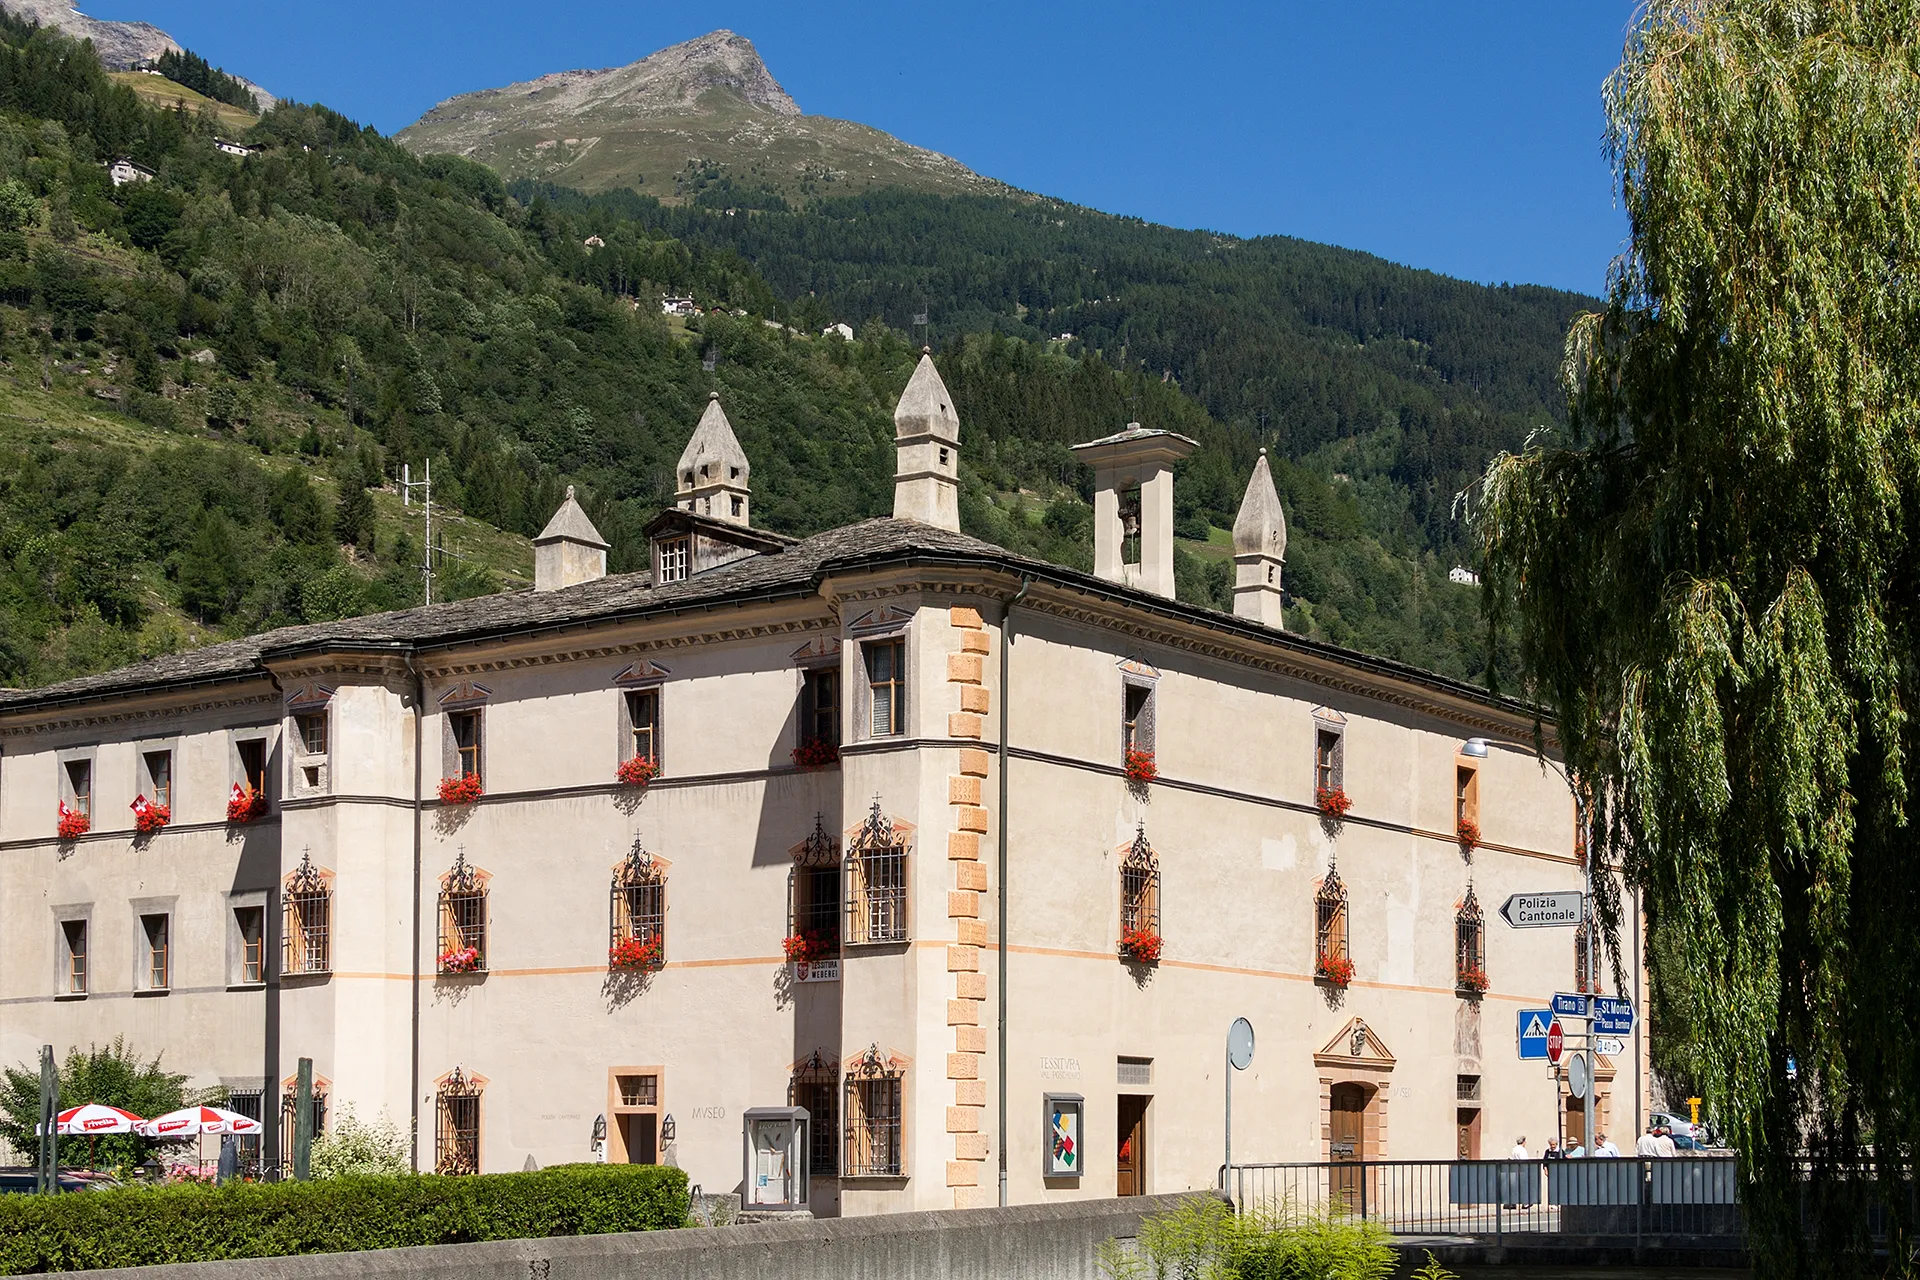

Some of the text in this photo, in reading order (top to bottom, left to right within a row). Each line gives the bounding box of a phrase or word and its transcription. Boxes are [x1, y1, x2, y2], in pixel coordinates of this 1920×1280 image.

[1519, 898, 1556, 909] Polizia
[1519, 909, 1575, 921] Cantonale
[812, 961, 838, 969] TESSITURA
[811, 970, 838, 978] WEBEREI
[1557, 997, 1576, 1011] Tirano
[1549, 1036, 1562, 1049] STOP
[88, 1118, 115, 1128] rivella
